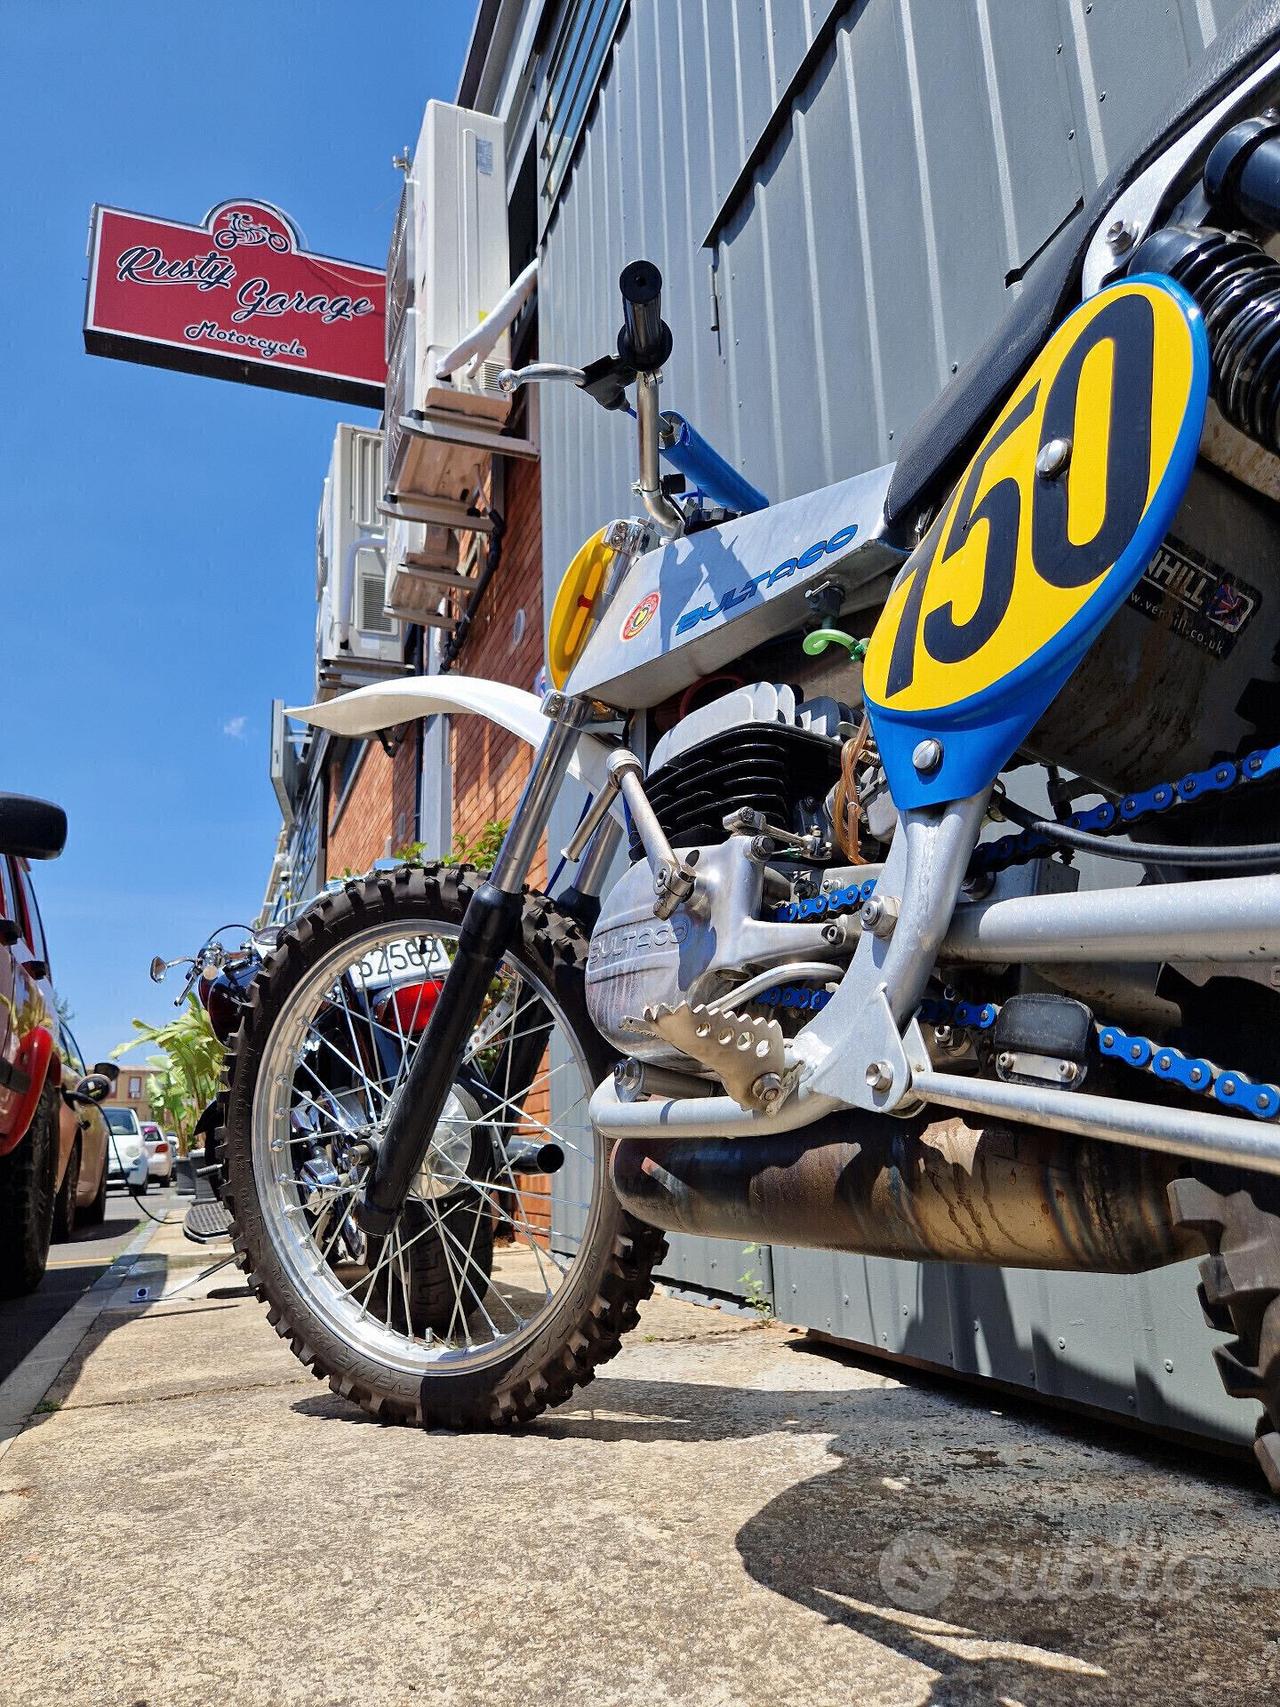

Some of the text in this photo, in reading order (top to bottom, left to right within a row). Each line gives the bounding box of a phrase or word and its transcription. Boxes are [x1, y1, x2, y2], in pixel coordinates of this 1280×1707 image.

[117, 246, 236, 290] Rusty
[232, 278, 374, 324] Garage
[184, 321, 307, 358] Motorcycle
[675, 523, 859, 636] BULTACO
[589, 919, 689, 965] BULTACO
